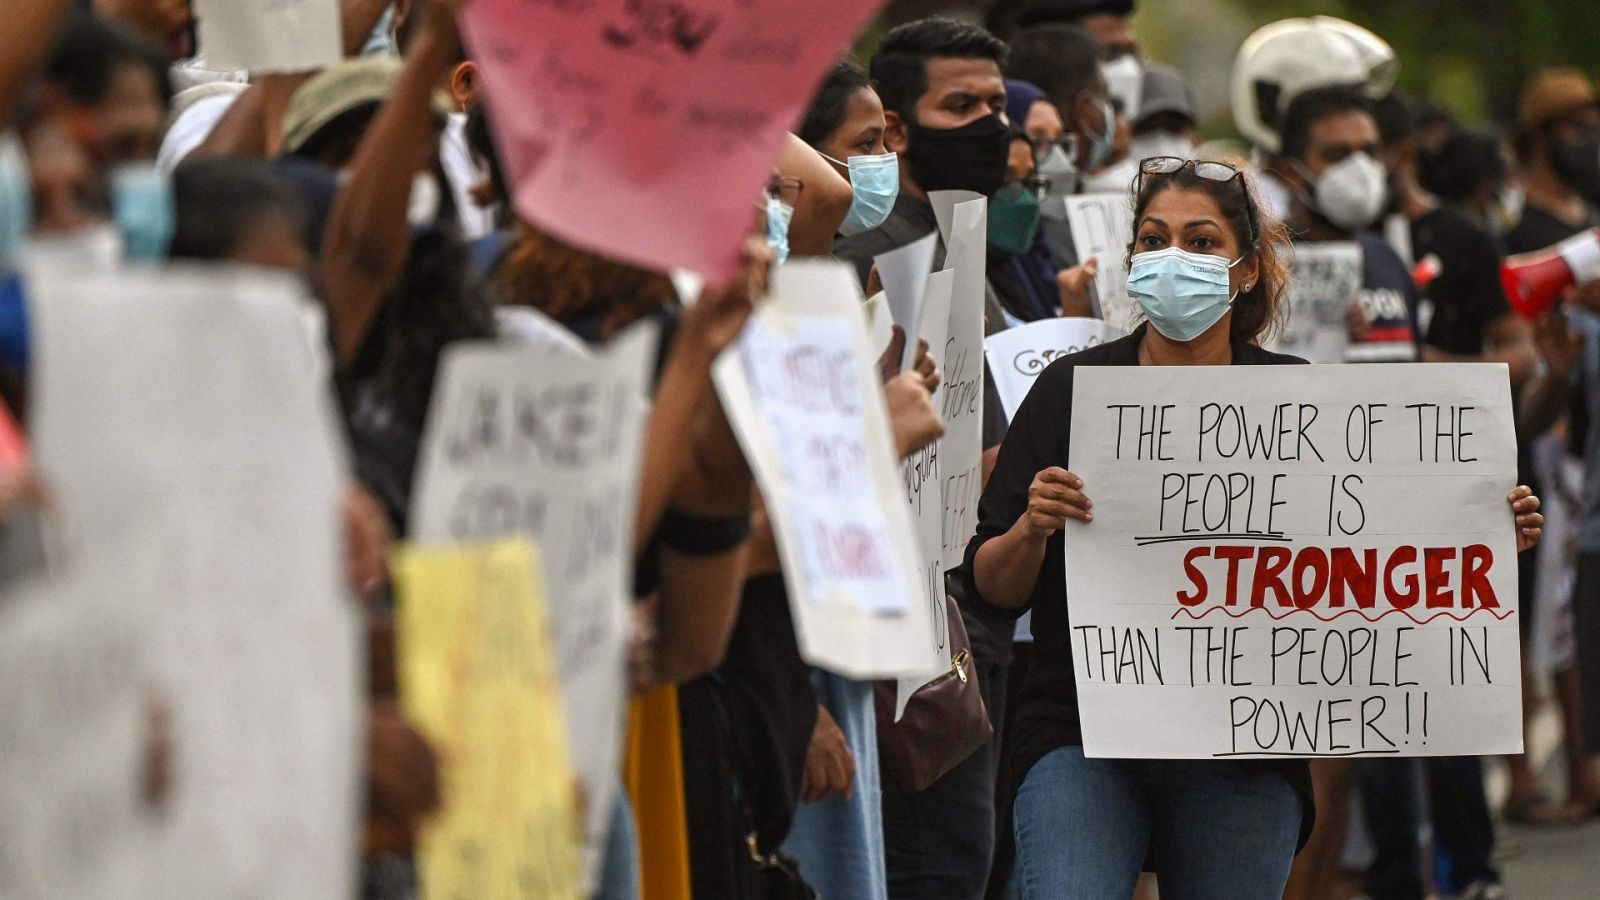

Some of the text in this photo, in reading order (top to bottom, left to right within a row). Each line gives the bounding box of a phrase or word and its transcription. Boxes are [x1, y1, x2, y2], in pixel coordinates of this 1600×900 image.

[1106, 402, 1478, 464] THE POWER OF THE
[1159, 472, 1366, 537] PEOPLE IS
[1176, 544, 1501, 609] STRONGER
[1073, 626, 1492, 688] THAN THE PEOPLE IN
[1229, 691, 1429, 752] POWER!!
